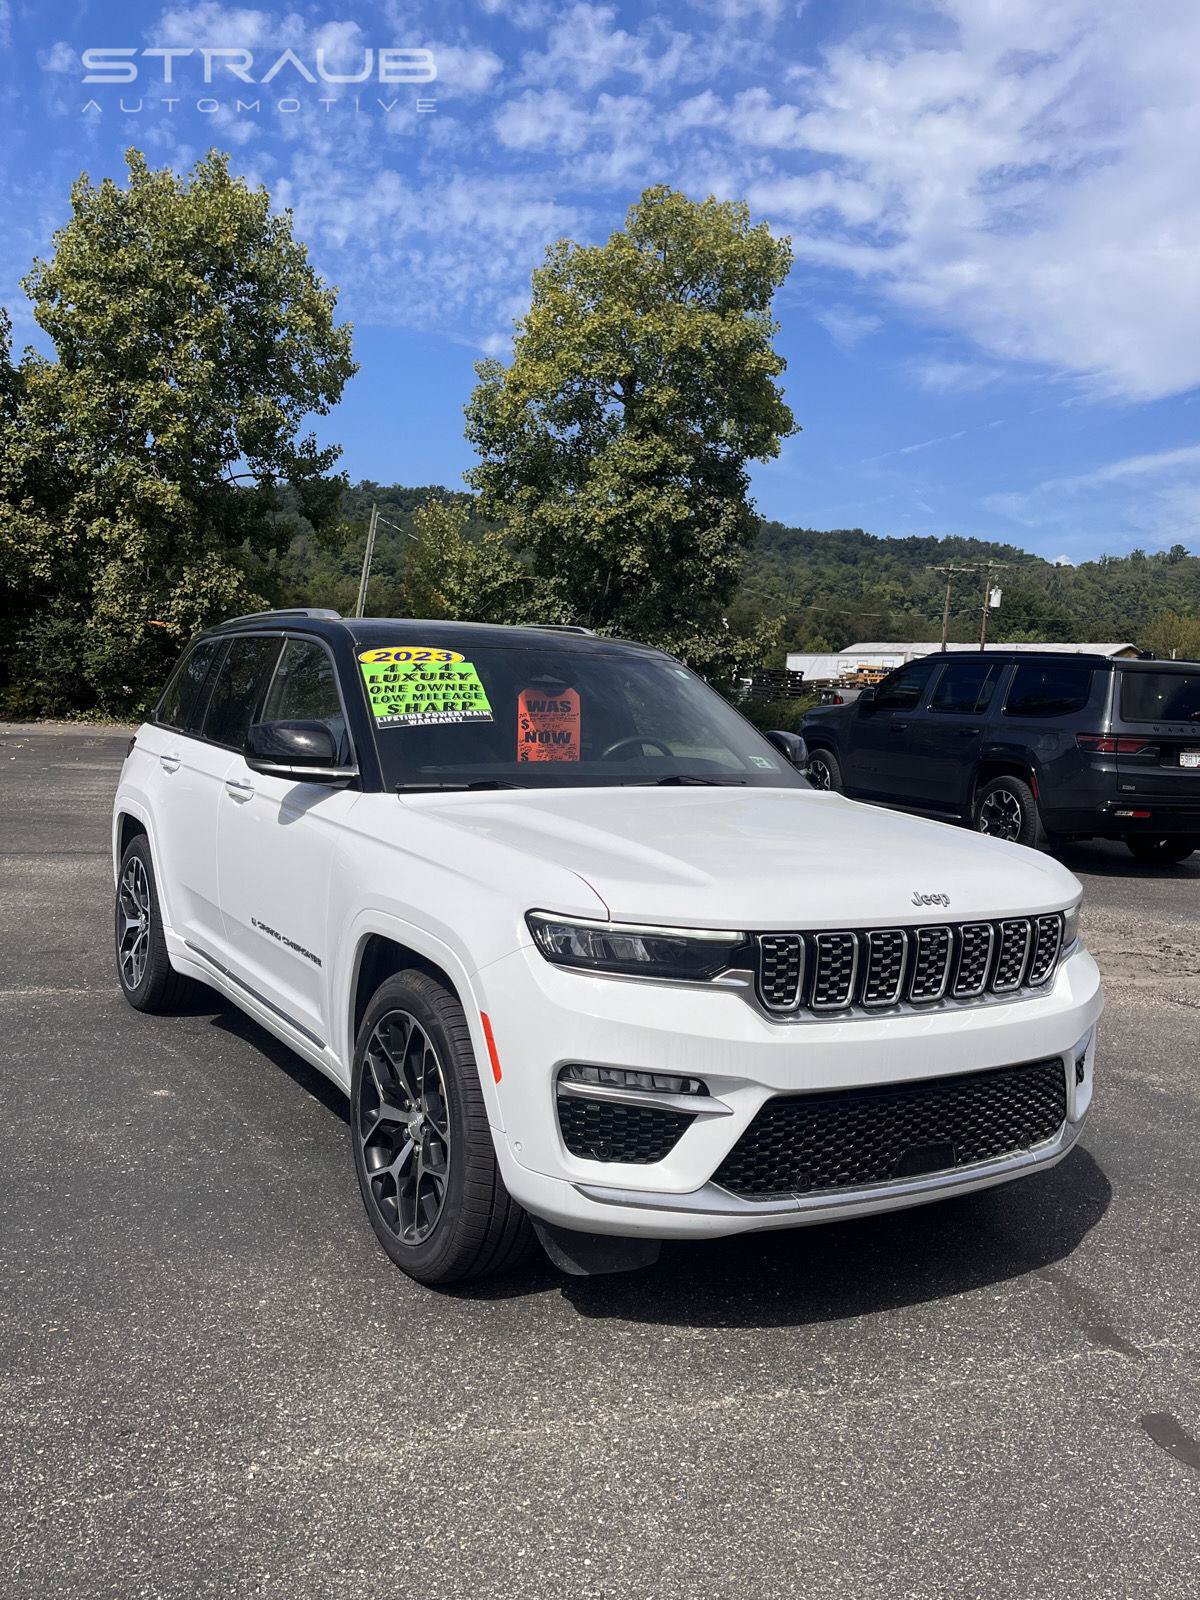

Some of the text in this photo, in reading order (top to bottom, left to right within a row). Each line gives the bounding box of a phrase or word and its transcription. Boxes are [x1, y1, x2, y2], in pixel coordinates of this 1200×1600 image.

[372, 651, 453, 662] 2023
[368, 672, 471, 684] LUXURY
[369, 683, 480, 694] ONE OWNER
[372, 692, 483, 704] LOW MILEAGE
[387, 701, 475, 714] SHARP
[526, 700, 572, 713] WAS
[377, 710, 490, 723] LIFETIME POWERTRAIN
[408, 716, 463, 725] WARRANTY
[525, 731, 572, 743] NOW
[911, 891, 950, 907] Jeep
